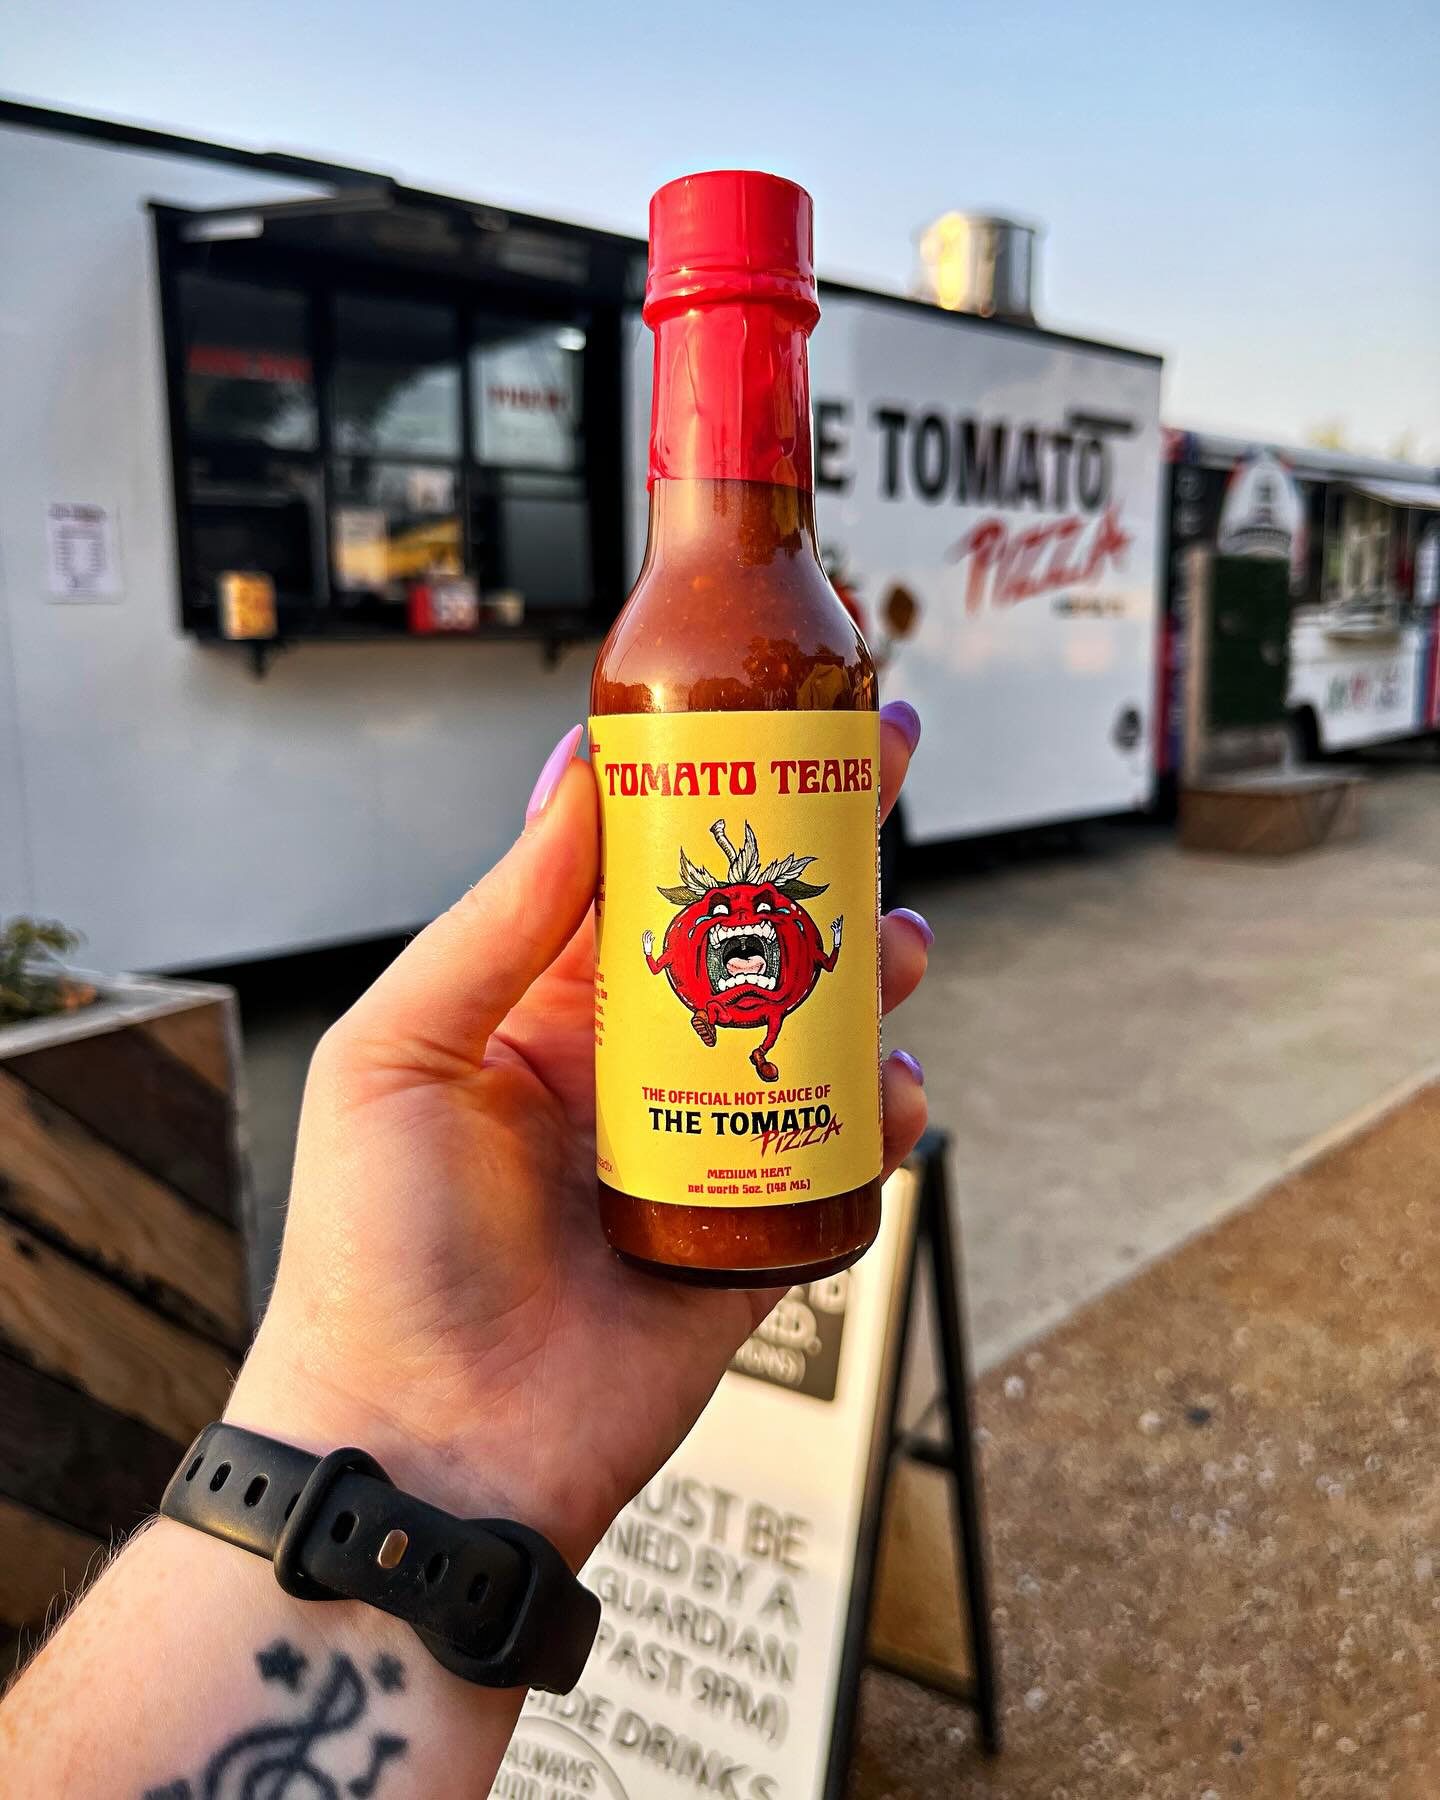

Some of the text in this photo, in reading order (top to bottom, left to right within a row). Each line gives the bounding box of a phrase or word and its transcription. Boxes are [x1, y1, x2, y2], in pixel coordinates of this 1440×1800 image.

[875, 408, 1112, 511] TOMATO
[605, 758, 873, 796] TOMATO TEARS
[642, 1084, 831, 1106] THE OFFICIAL HOT SAUCE OF
[648, 1104, 831, 1136] THE TOMATO
[750, 1112, 844, 1158] PIZZA
[687, 1184, 704, 1193] net
[707, 1185, 739, 1195] worth
[742, 1184, 763, 1194] 5oz.
[766, 1182, 787, 1194] (148
[707, 1166, 792, 1179] MEDIUM HEAT
[634, 1473, 812, 1577] UST BE
[692, 1545, 758, 1608] BY
[757, 1575, 802, 1635] A
[587, 1563, 799, 1690] GUARDIAN
